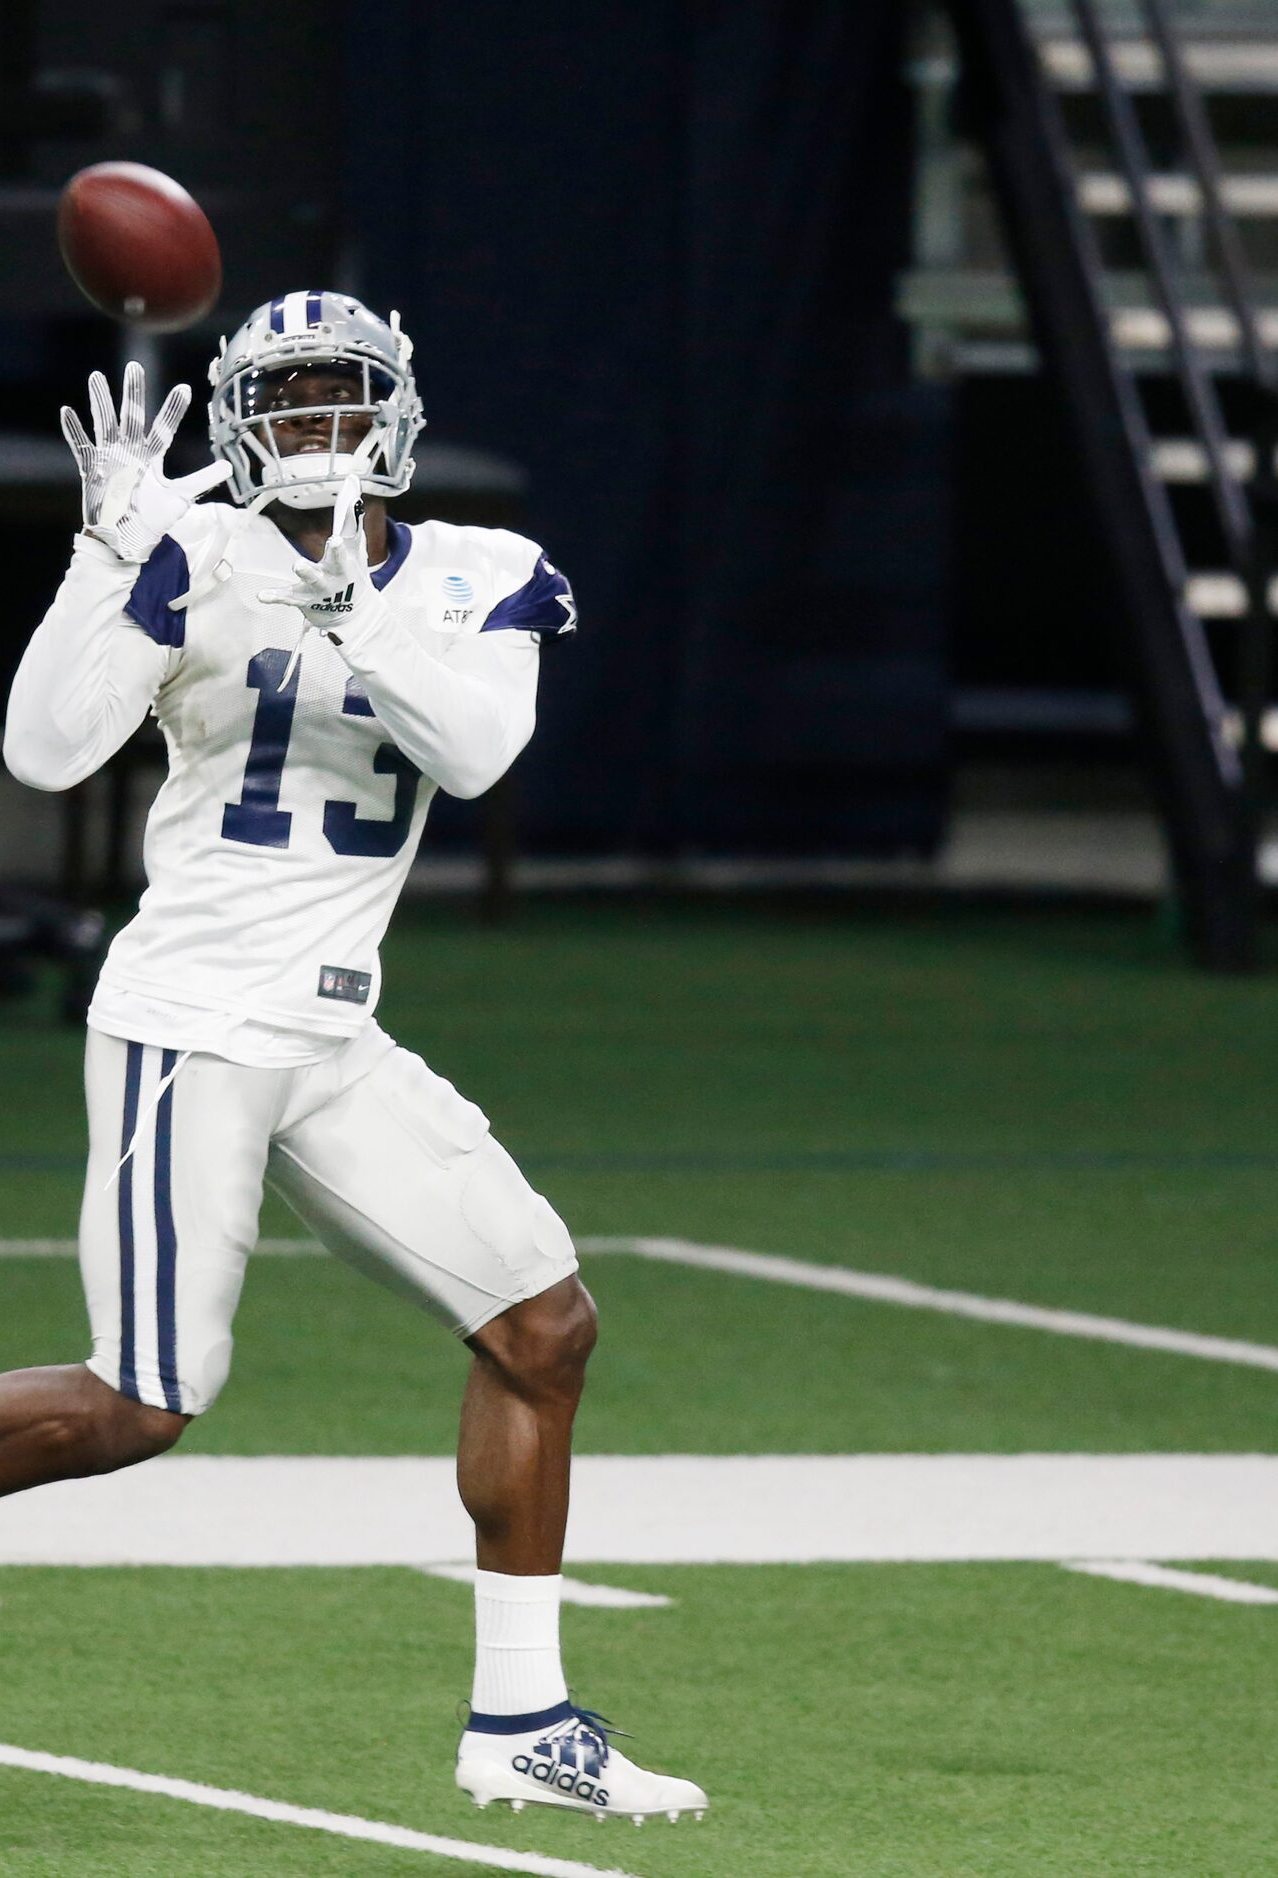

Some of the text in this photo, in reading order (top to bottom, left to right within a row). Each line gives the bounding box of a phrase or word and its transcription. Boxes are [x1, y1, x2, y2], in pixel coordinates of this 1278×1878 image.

[311, 602, 354, 612] adidas
[442, 609, 474, 624] AT&
[221, 647, 423, 858] 13
[512, 1754, 610, 1807] adidas
